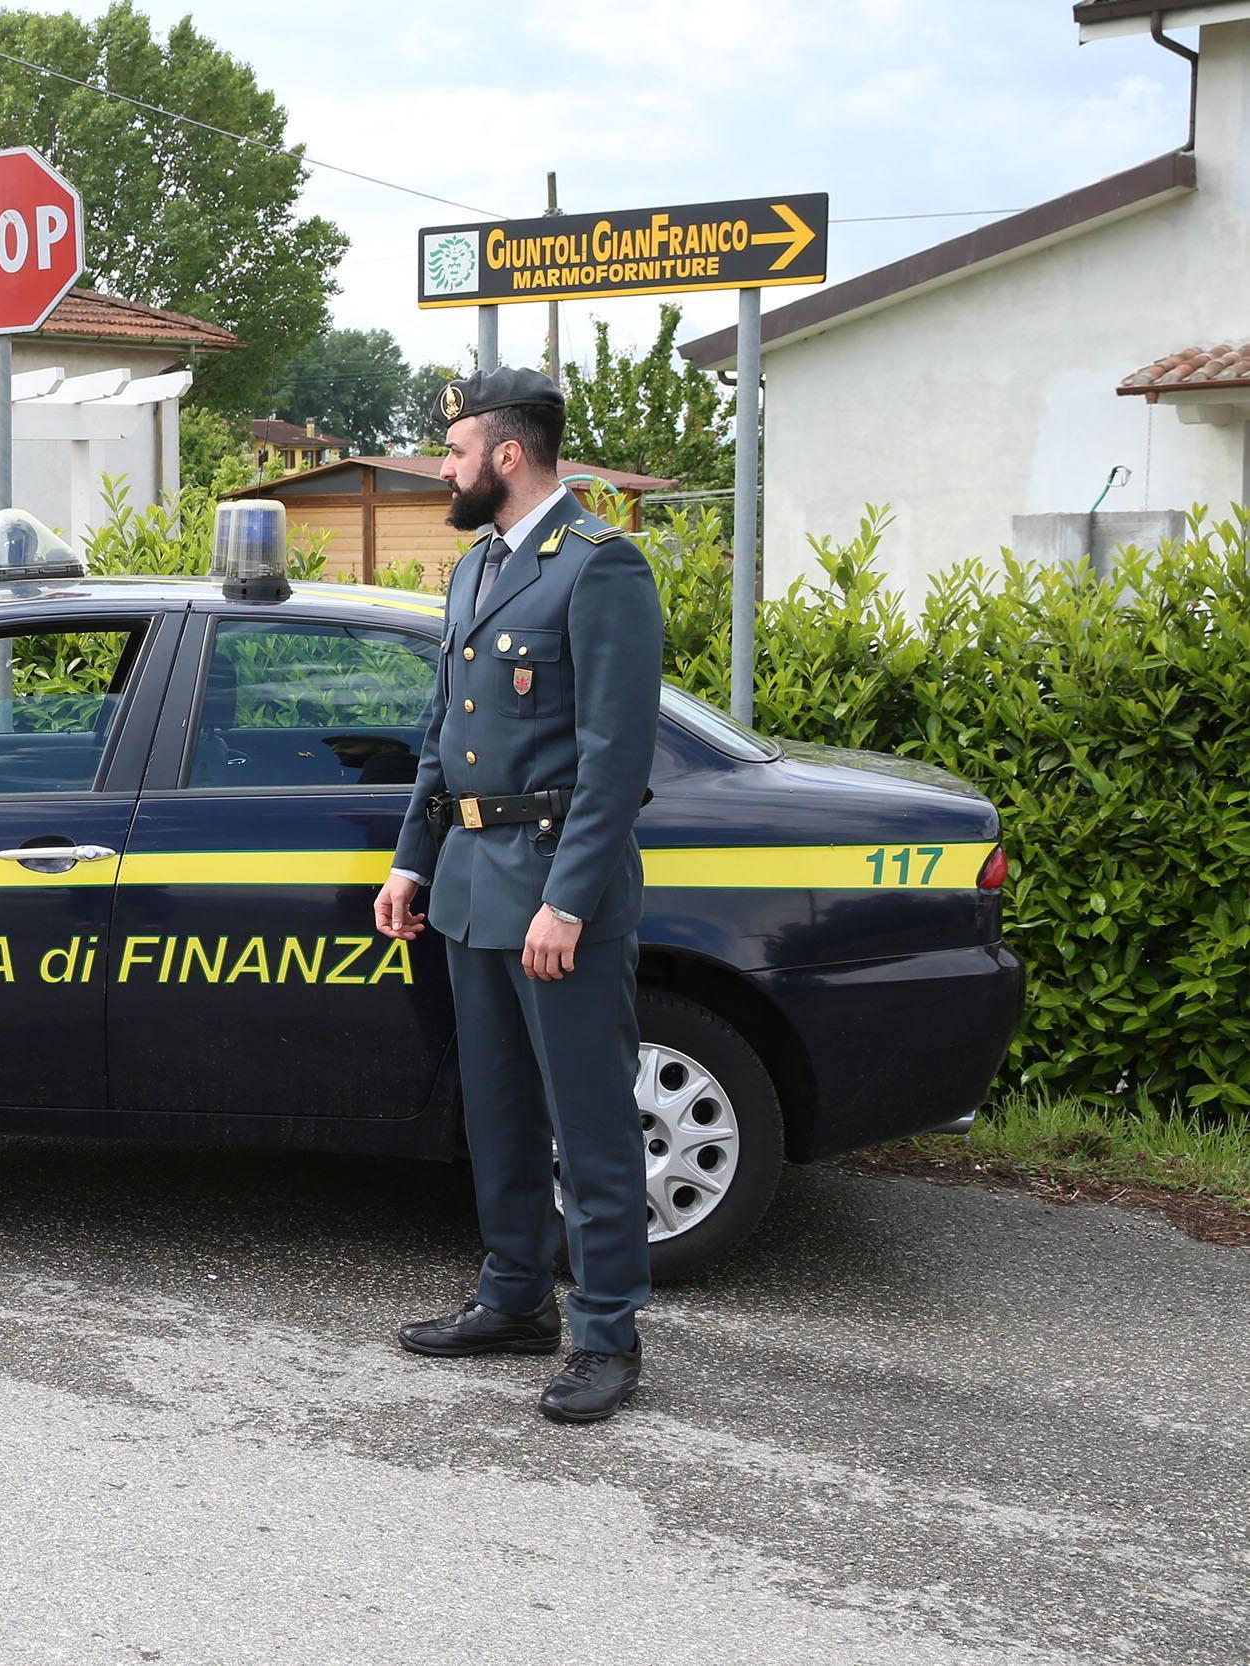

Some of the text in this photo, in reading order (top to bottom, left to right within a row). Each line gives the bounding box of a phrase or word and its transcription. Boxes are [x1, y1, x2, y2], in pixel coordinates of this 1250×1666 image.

[512, 256, 720, 290] MARMOFORNITURE
[865, 847, 944, 886] 117
[38, 934, 97, 984] di
[117, 936, 415, 985] FINANZA
